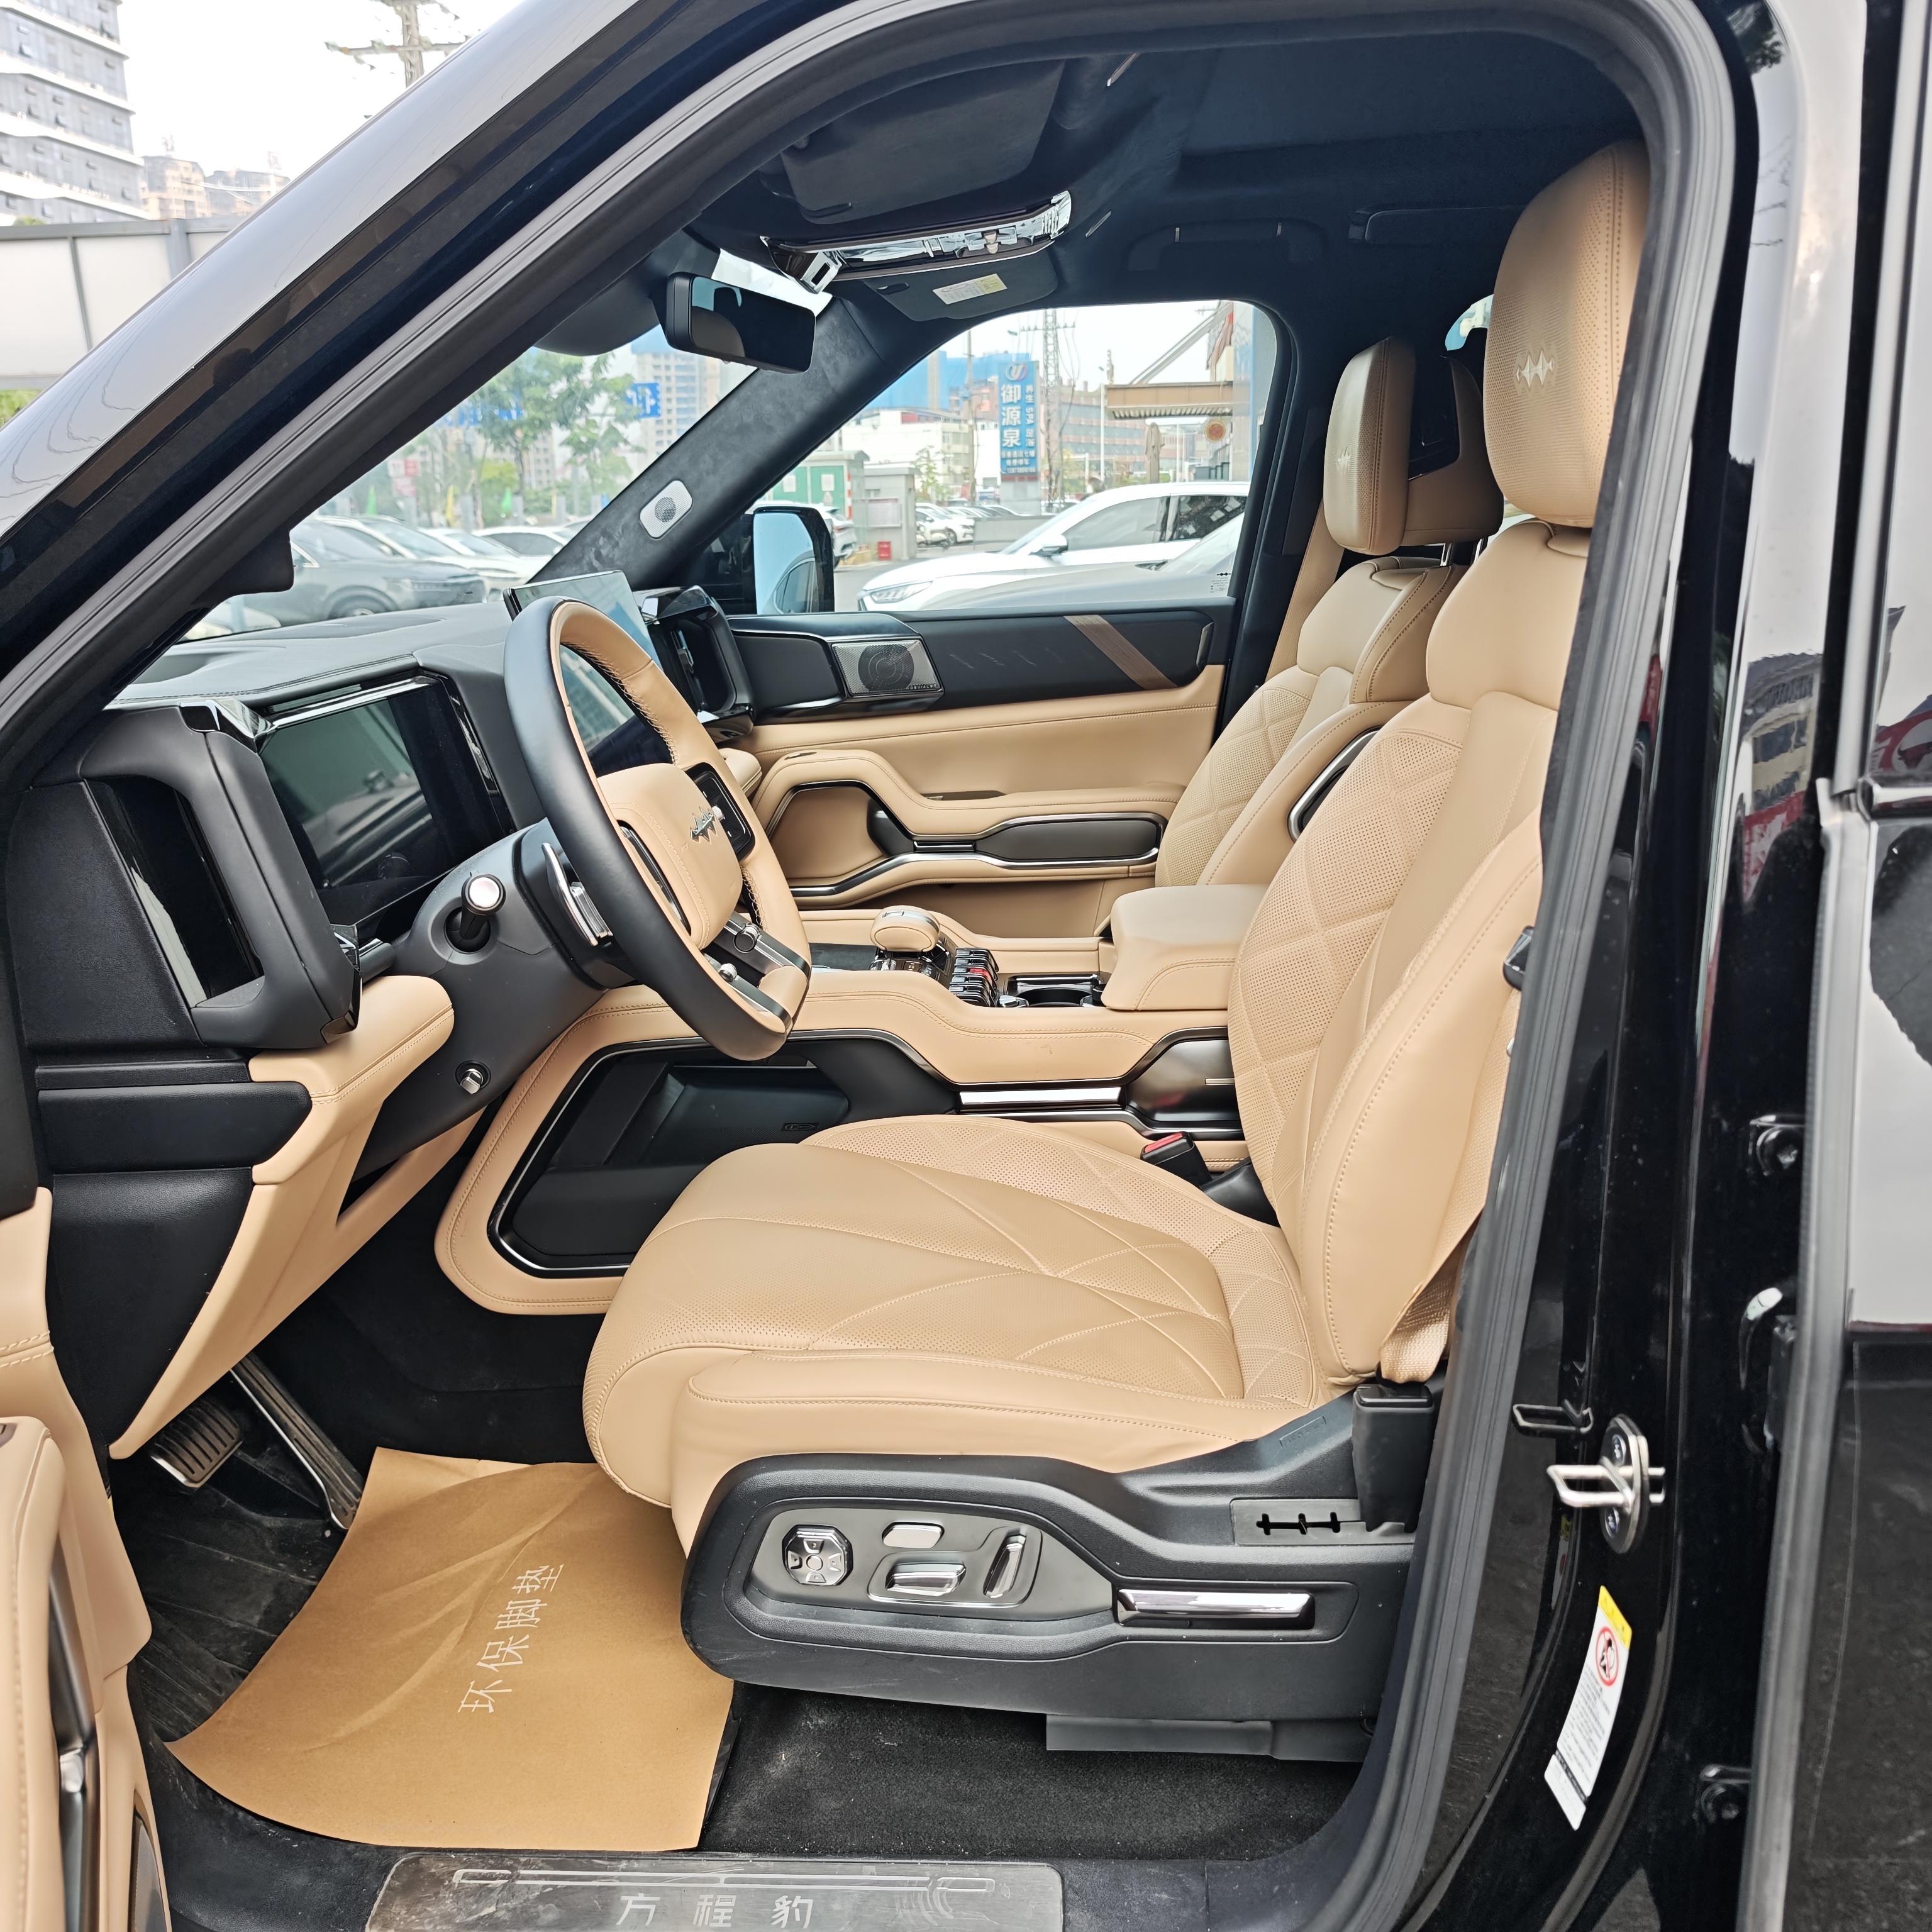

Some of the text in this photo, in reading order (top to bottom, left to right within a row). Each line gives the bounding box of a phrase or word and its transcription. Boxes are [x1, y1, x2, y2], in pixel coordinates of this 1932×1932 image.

[1001, 384, 1021, 448] 御源泉
[457, 1563, 564, 1713] 环保脚垫
[616, 1892, 814, 1929] 方程豹
